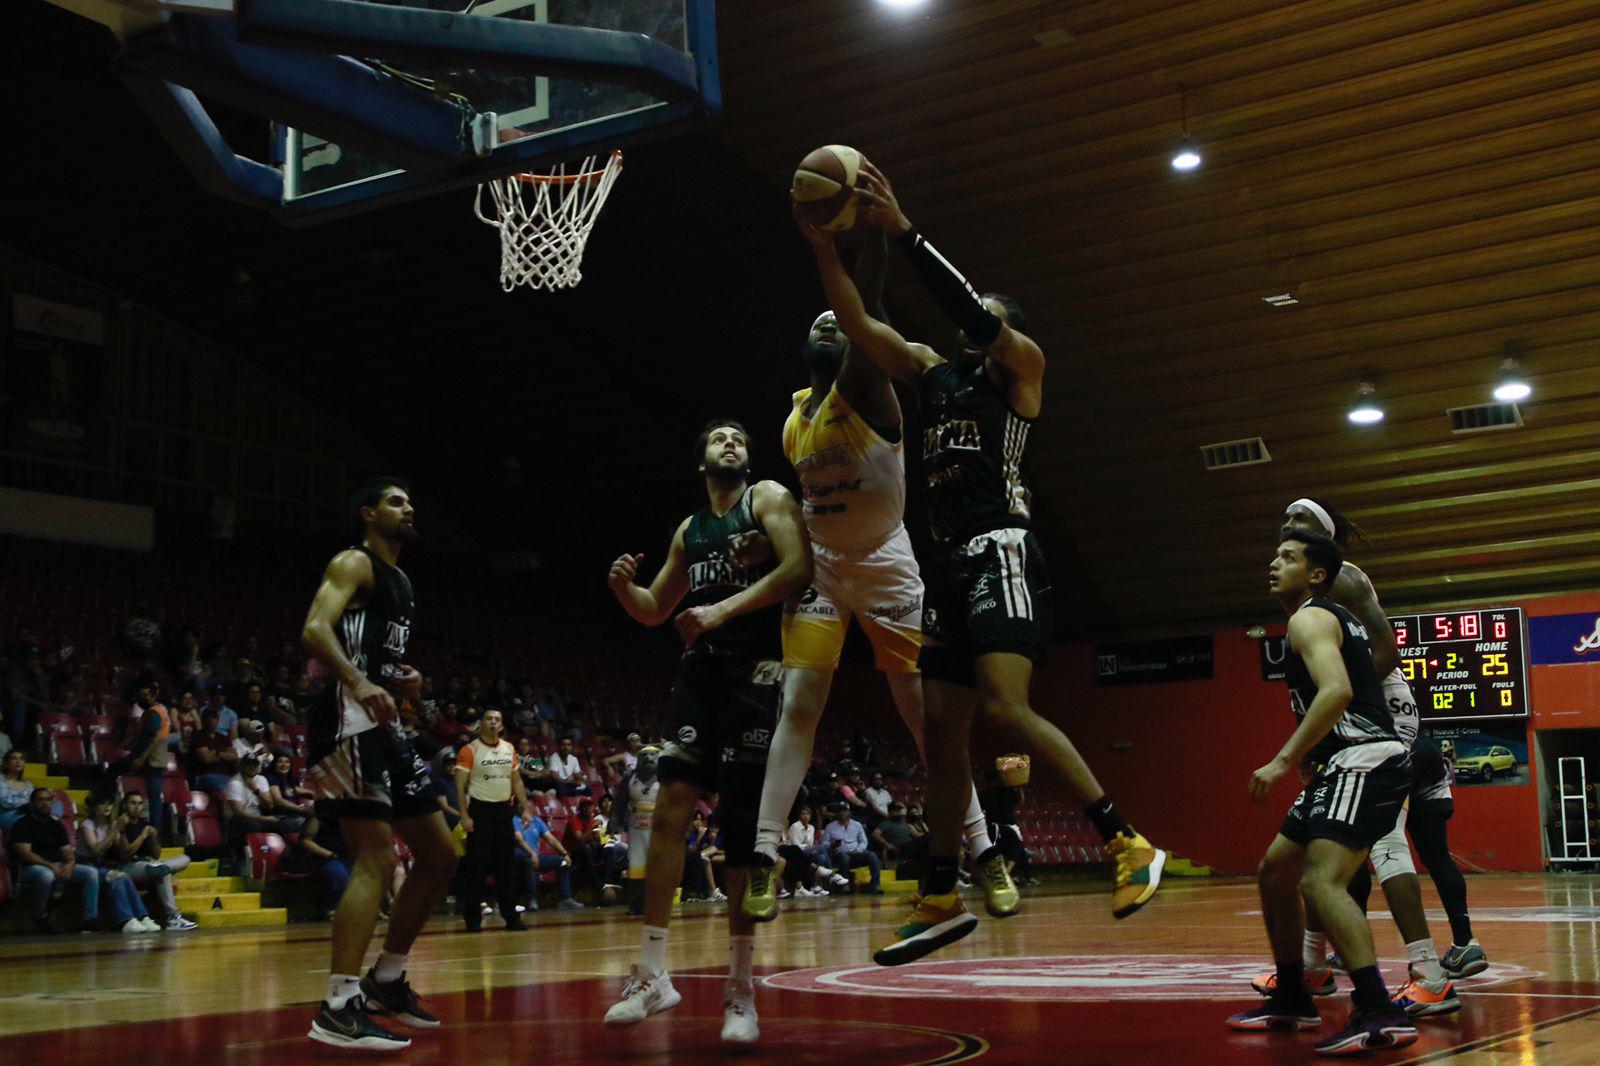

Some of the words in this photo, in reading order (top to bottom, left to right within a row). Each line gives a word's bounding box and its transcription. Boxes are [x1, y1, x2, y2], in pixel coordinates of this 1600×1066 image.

[1435, 614, 1478, 638] 5:18
[1494, 621, 1506, 639] 0
[1395, 628, 1408, 645] 2
[1398, 647, 1430, 656] UEST
[1475, 642, 1509, 652] HOME
[1401, 658, 1428, 681] 37
[1446, 653, 1457, 669] 2
[1481, 653, 1509, 676] 25
[1436, 671, 1469, 680] PERIOD
[1429, 683, 1478, 692] PLAYER-FOUL
[1491, 681, 1515, 689] FOULS
[1432, 692, 1454, 710] 02
[1469, 691, 1476, 708] 1
[1500, 689, 1512, 707] 0
[1455, 727, 1481, 736] T-Cross
